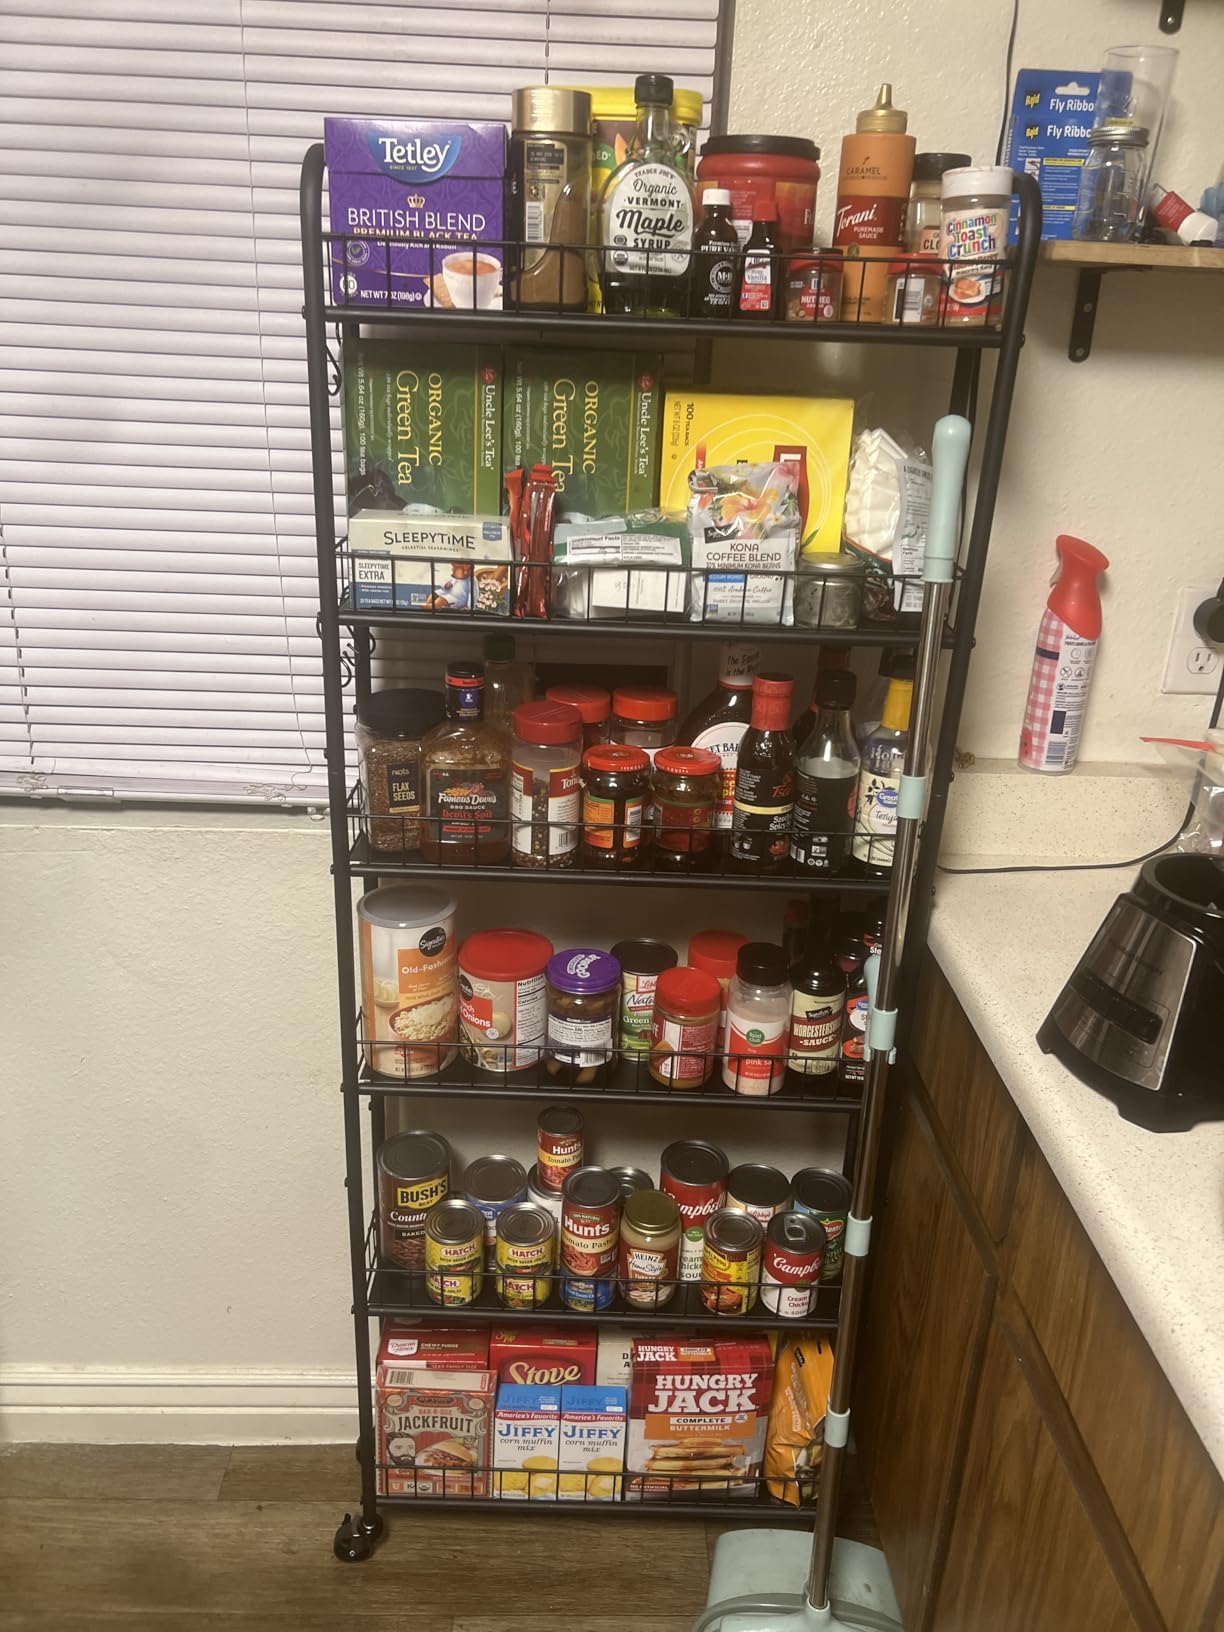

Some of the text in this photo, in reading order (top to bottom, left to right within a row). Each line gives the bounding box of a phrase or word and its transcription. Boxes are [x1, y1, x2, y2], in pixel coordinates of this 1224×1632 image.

[1050, 99, 1094, 112] Fly Ribbo
[1047, 125, 1092, 139] Fly Ribbo
[379, 137, 450, 172] Tetley
[634, 168, 658, 179] TRADER
[846, 166, 880, 176] CARAMEL
[633, 179, 678, 199] Organic
[627, 196, 681, 209] VERMONT
[348, 207, 486, 232] BRITISH BLEND
[616, 208, 685, 235] Maple
[837, 203, 877, 238] Torani
[947, 214, 997, 234] Cinnamon
[854, 226, 884, 234] PUREMADE
[633, 237, 671, 249] SYRUP
[923, 239, 940, 250] CLO
[948, 234, 996, 258] Crunch
[801, 294, 831, 306] NUTEG
[686, 402, 694, 420] 100
[428, 372, 443, 466] ORGANIC
[396, 370, 420, 486] Green Tea
[484, 384, 496, 468] Uncle Lee's Tea
[582, 380, 599, 474] ORGANIC
[552, 378, 576, 494] Green Tea
[638, 392, 652, 475] Uncle Lee's Tea
[730, 544, 760, 552] KONA
[706, 552, 782, 562] COFFEE BLEND
[358, 562, 390, 570] SLEEPYTIME
[358, 570, 386, 581] EXTRA
[392, 782, 410, 792] FLAX
[393, 792, 416, 802] SEEDS
[876, 810, 898, 824] Teriya
[517, 975, 544, 987] Nutrition
[462, 1008, 491, 1028] Onions
[622, 1016, 650, 1024] Green
[400, 1179, 448, 1204] BUSH'S
[444, 1243, 476, 1256] HATCH
[512, 1247, 544, 1258] HATCH
[634, 1252, 660, 1263] HEINZ
[430, 1272, 457, 1287] HACH
[637, 1352, 678, 1362] JACK
[508, 1362, 582, 1386] Stove
[655, 1374, 759, 1390] HUNGRY
[648, 1388, 757, 1414] JACK
[497, 1412, 530, 1420] America's
[563, 1413, 596, 1422] America's
[398, 1416, 474, 1434] JACKFRUIT
[522, 1438, 553, 1446] muffin
[587, 1440, 618, 1448] muffin
